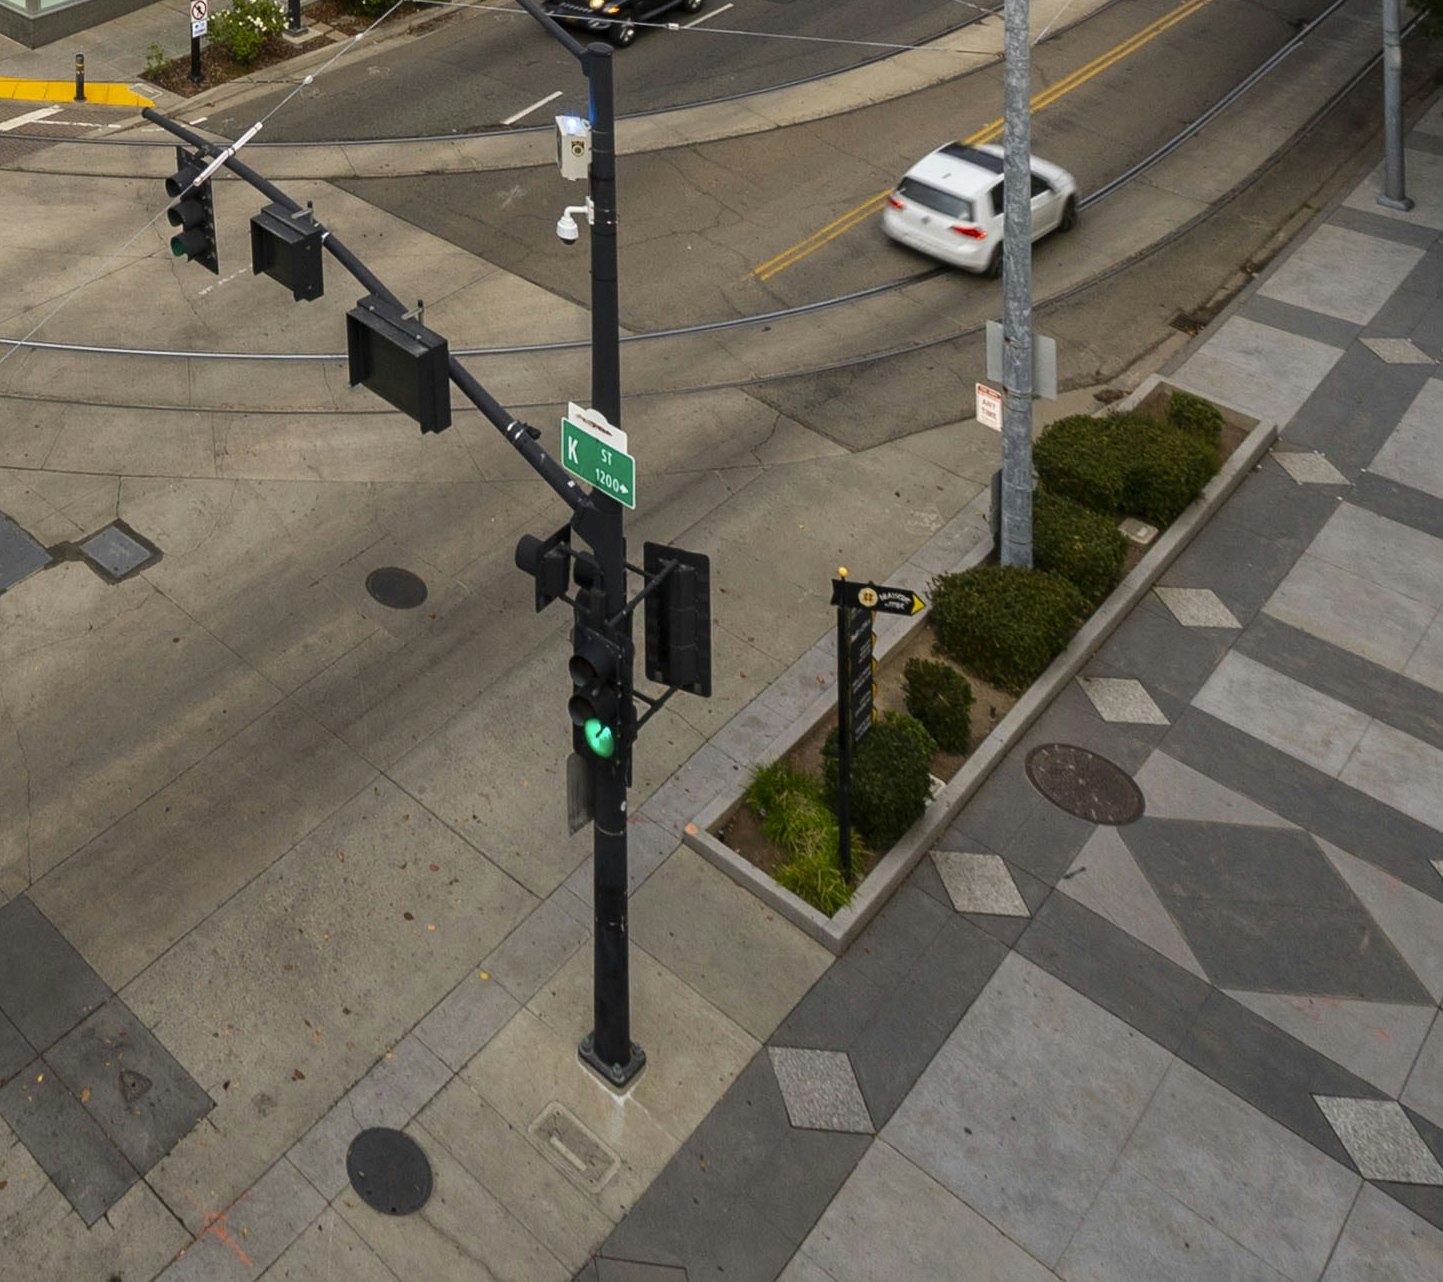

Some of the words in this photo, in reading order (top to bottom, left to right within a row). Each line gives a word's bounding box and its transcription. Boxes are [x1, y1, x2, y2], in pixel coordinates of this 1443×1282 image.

[568, 435, 579, 465] K
[601, 448, 613, 466] ST
[596, 468, 620, 493] 1200
